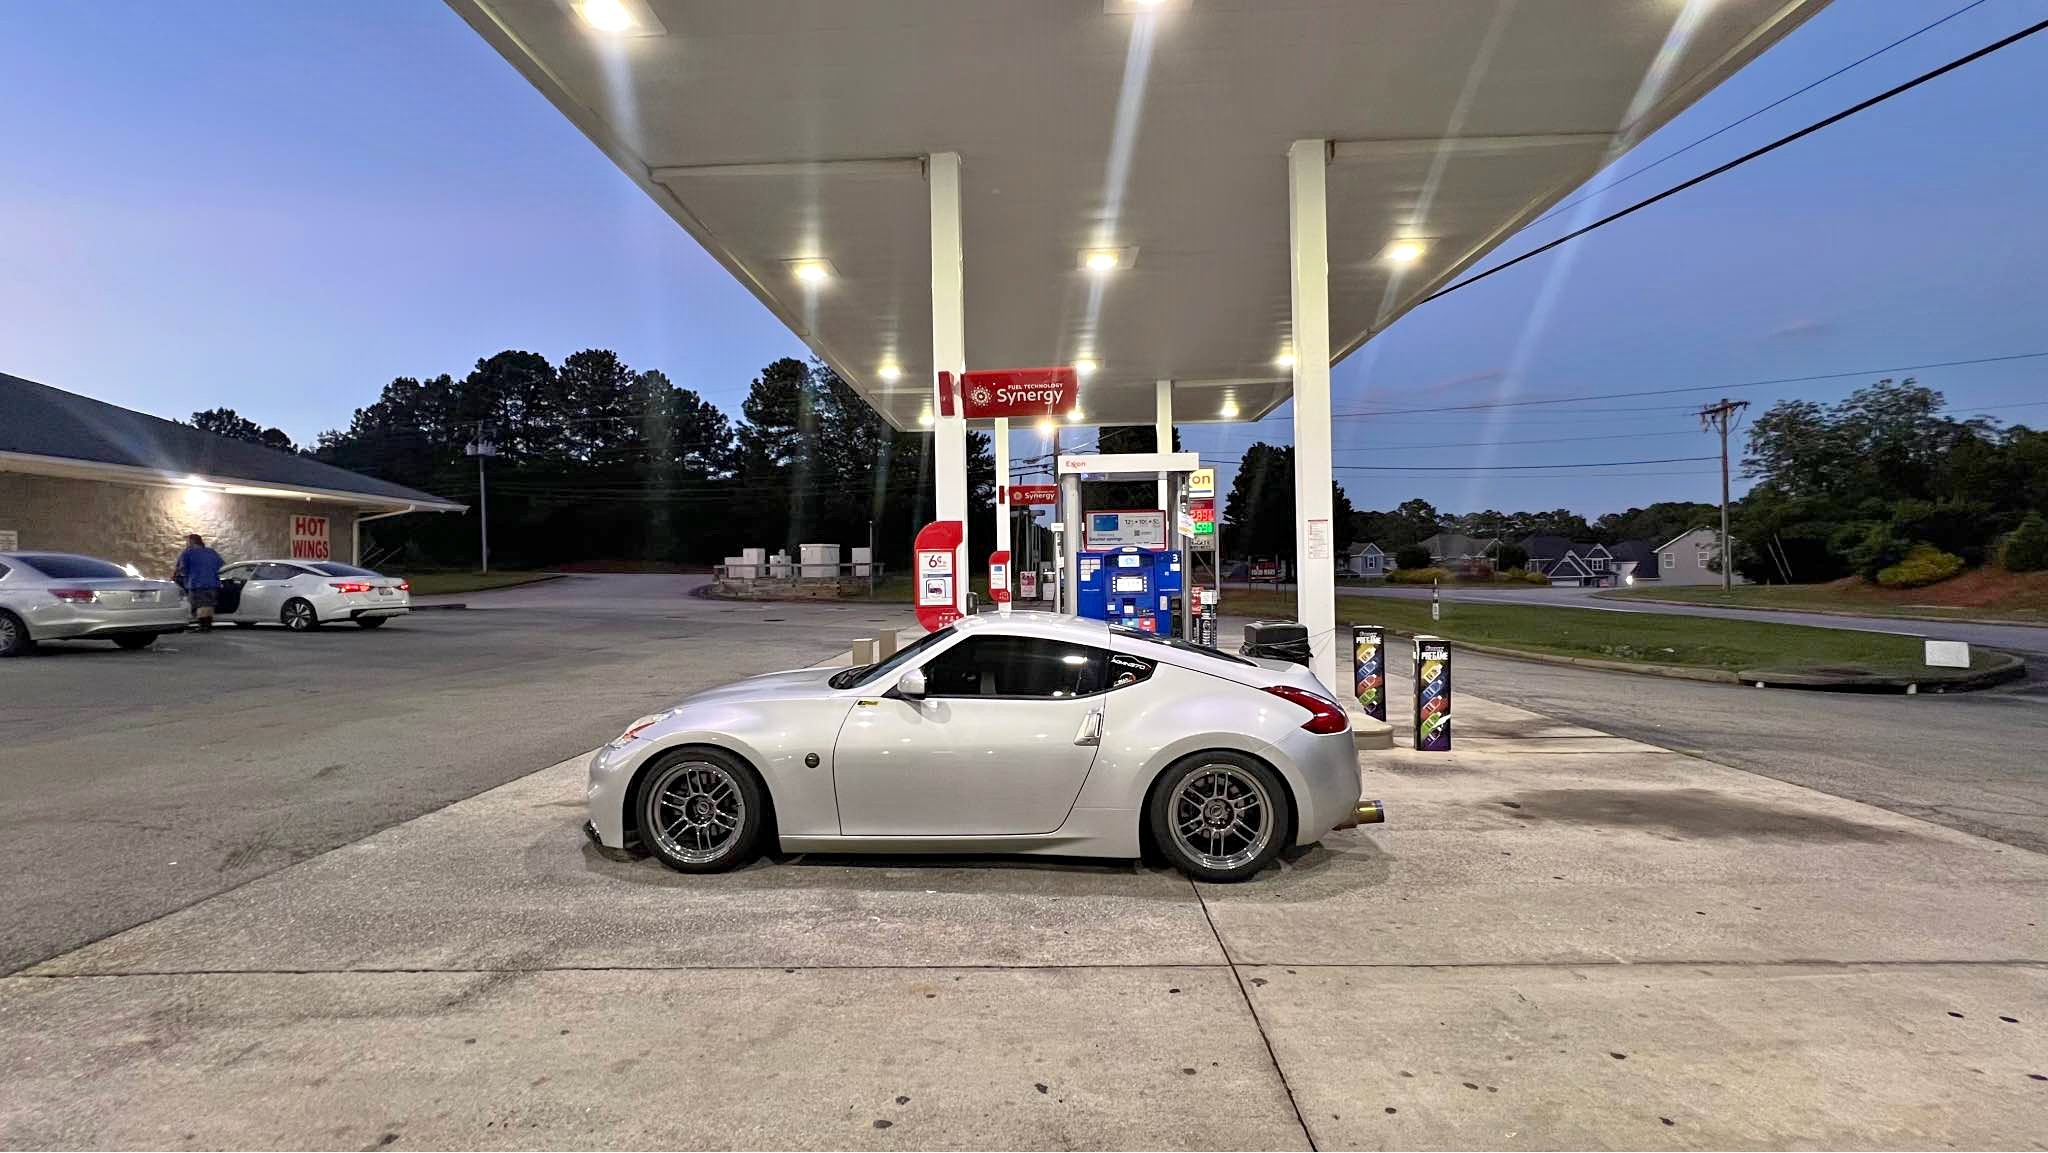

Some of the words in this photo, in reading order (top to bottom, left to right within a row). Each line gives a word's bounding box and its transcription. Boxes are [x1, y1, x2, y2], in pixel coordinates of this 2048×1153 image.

[996, 388, 1063, 406] Synergy
[1024, 492, 1055, 500] Synergy
[295, 516, 325, 536] HOT
[292, 540, 329, 559] WINGS
[1172, 554, 1178, 562] 3
[1355, 635, 1382, 644] PREGAME
[1420, 651, 1449, 660] PREGAME
